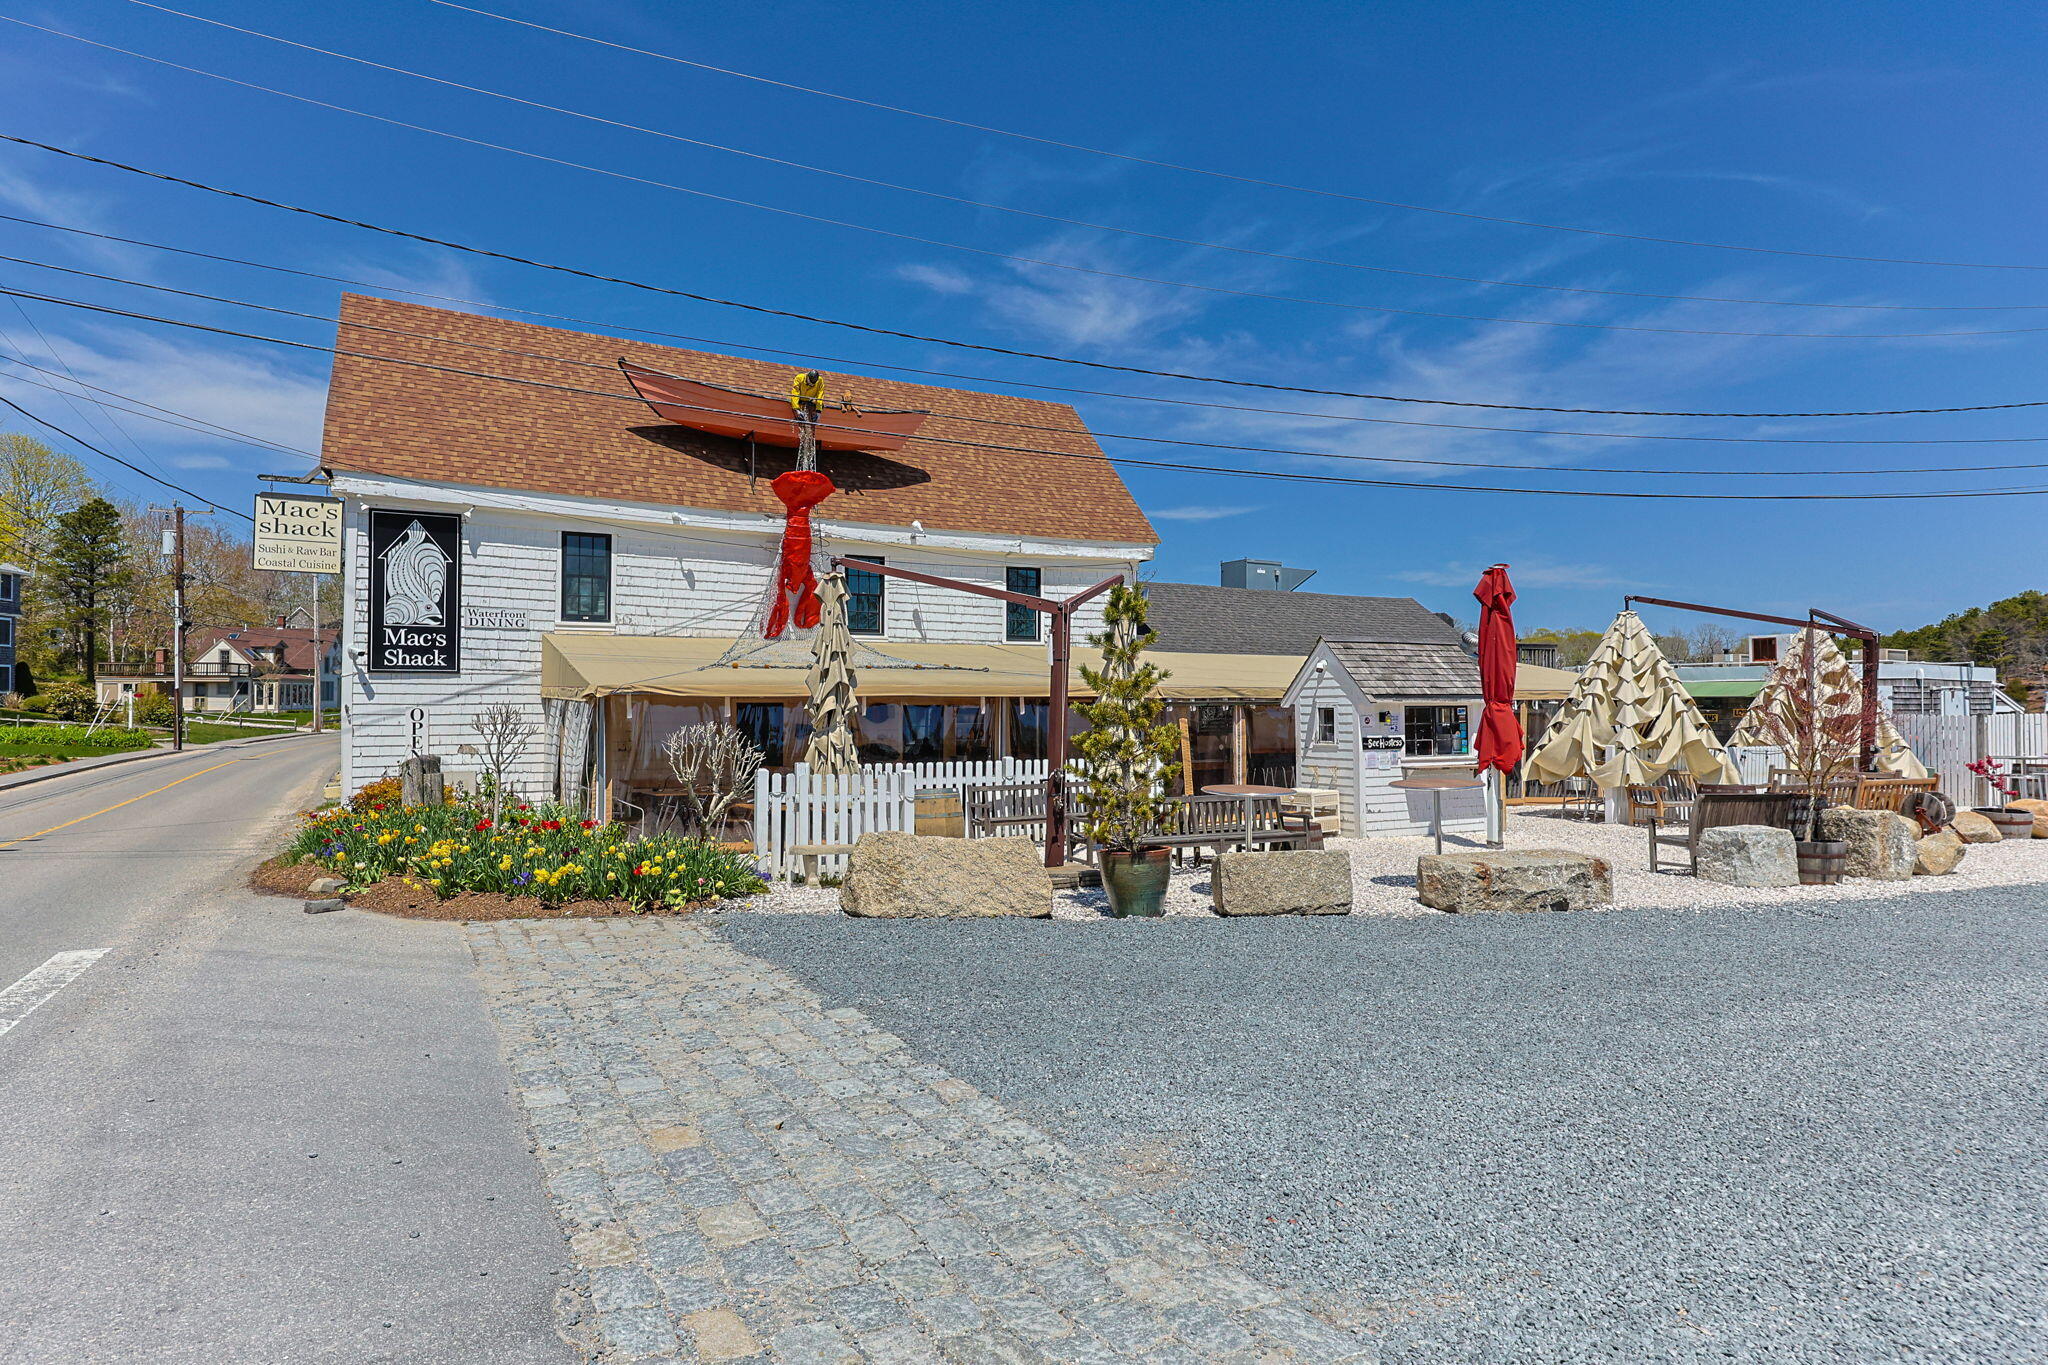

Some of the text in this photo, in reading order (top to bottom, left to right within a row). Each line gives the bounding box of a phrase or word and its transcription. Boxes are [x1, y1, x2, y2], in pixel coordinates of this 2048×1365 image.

[261, 499, 338, 520] Mac's
[259, 517, 336, 538] shack
[258, 543, 286, 554] Sushi
[296, 545, 318, 556] Raw
[319, 547, 337, 557] Bar
[258, 556, 337, 570] Coastal Cuisine
[468, 608, 527, 619] Waterfront
[469, 617, 525, 628] DINING
[382, 627, 447, 647] Mac's
[383, 648, 448, 667] Shack
[1368, 738, 1380, 749] See
